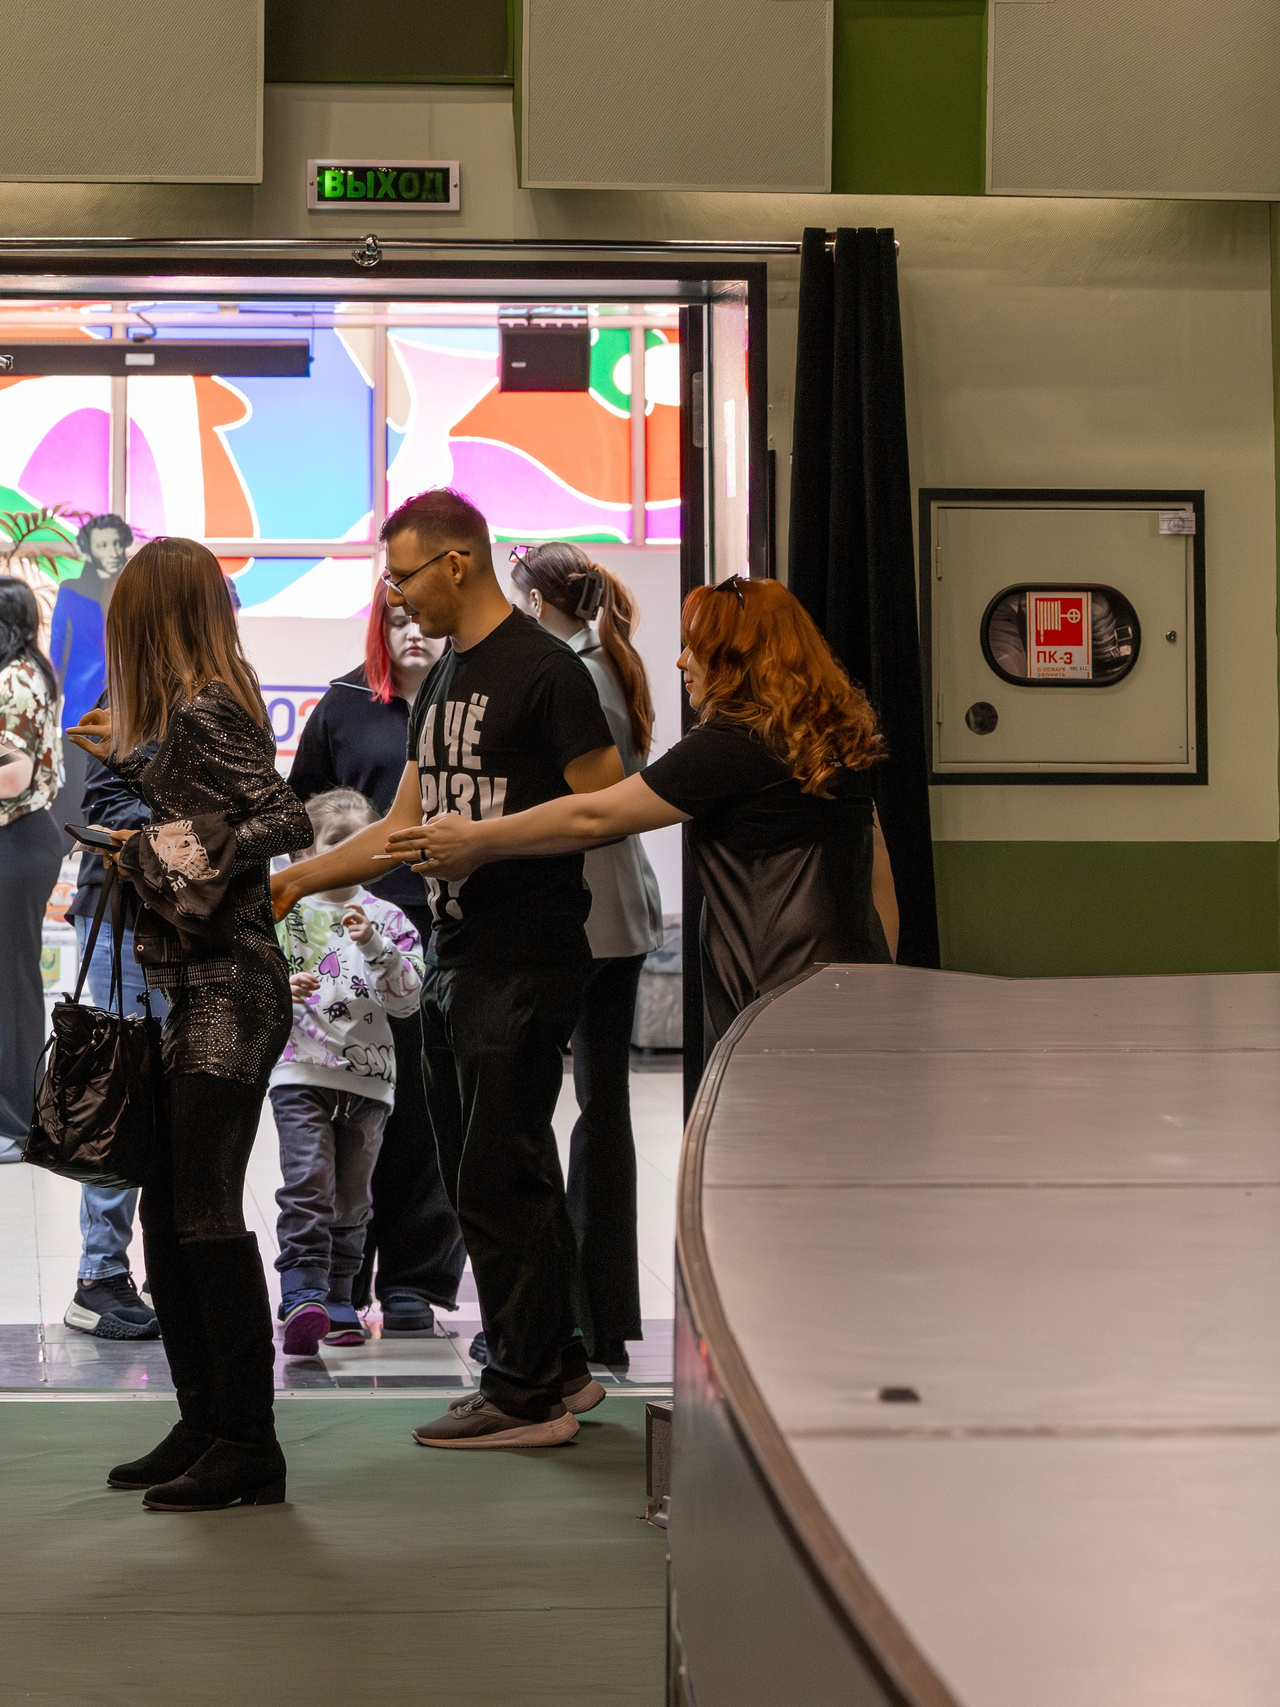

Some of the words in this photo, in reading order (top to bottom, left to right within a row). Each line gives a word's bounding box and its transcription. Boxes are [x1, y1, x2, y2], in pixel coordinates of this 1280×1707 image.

[324, 169, 445, 200] ВЫХОД
[1036, 650, 1073, 665] ПК-3
[444, 693, 489, 770] ЧЁ
